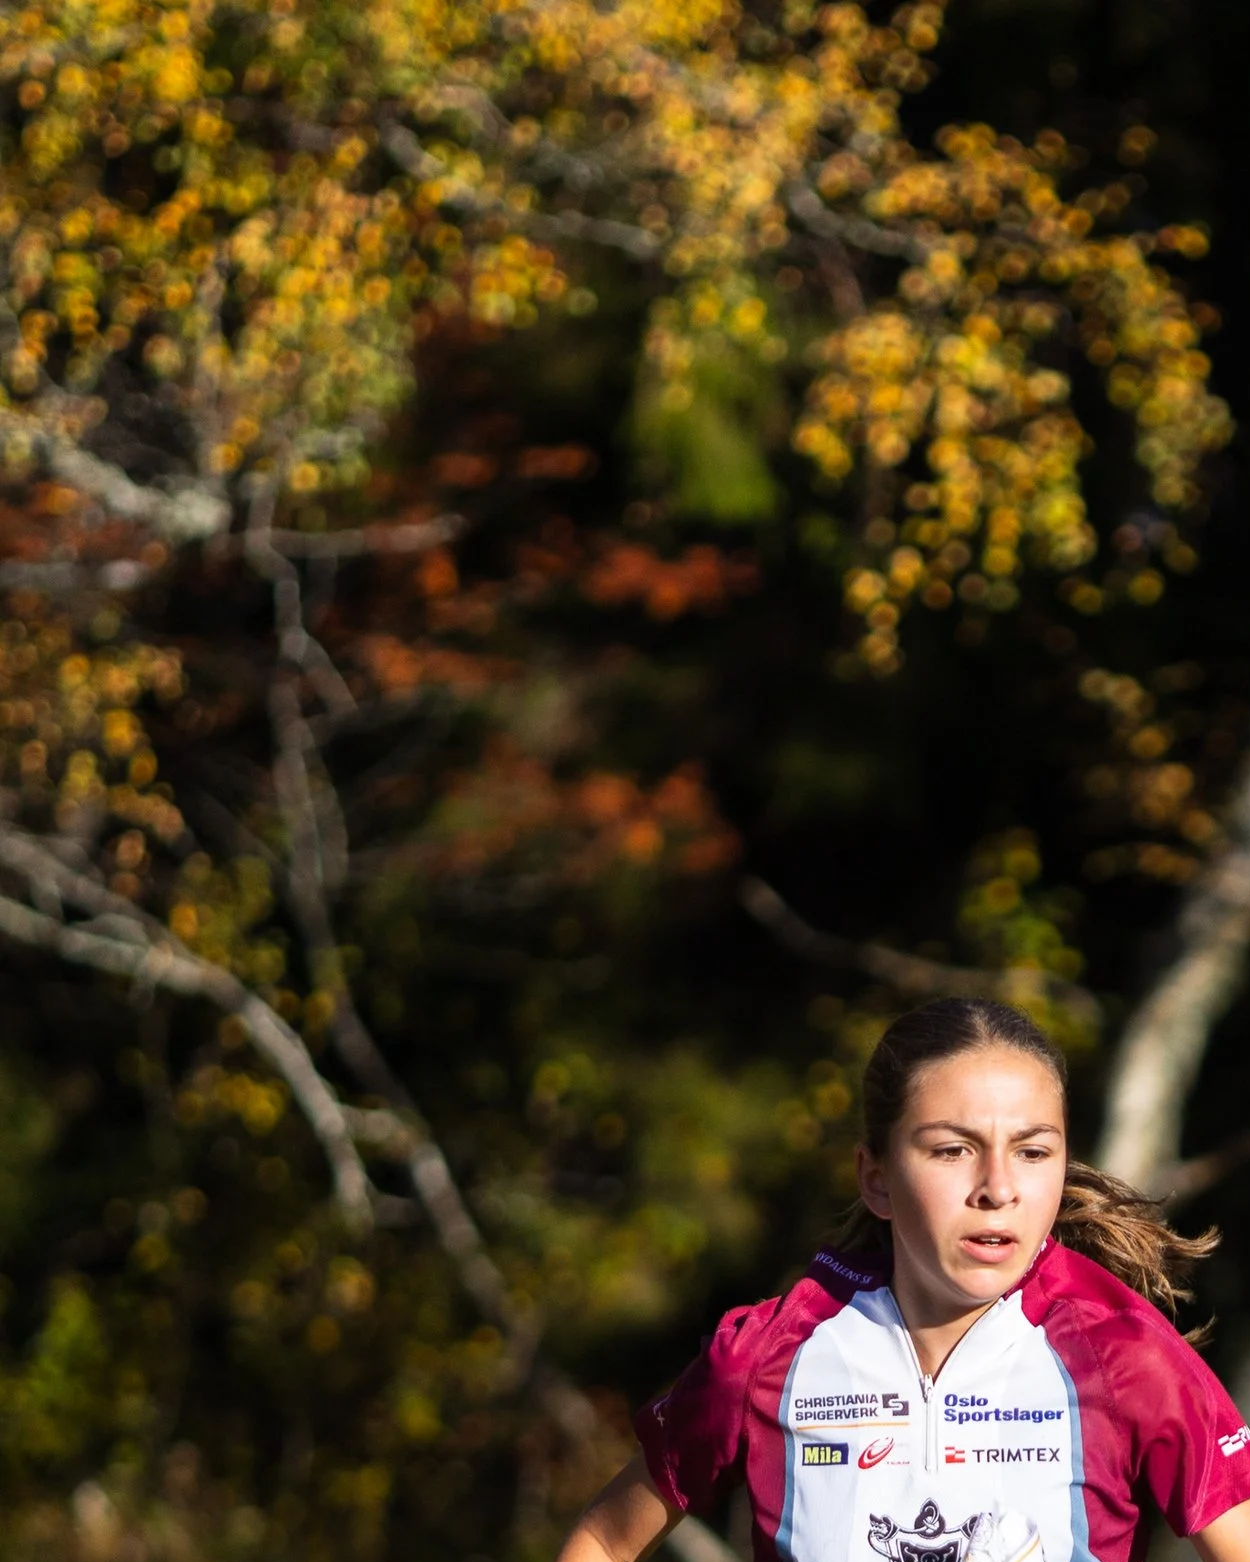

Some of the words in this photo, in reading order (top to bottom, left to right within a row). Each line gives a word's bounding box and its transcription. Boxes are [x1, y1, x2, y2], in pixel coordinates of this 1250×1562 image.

[794, 1394, 879, 1409] CHRISTIANIA
[944, 1393, 989, 1407] Oslo
[795, 1407, 878, 1421] SPIGERVERK
[944, 1407, 1065, 1425] Sportslager
[803, 1446, 842, 1464] Mila
[971, 1448, 1060, 1463] TRIMTEX
